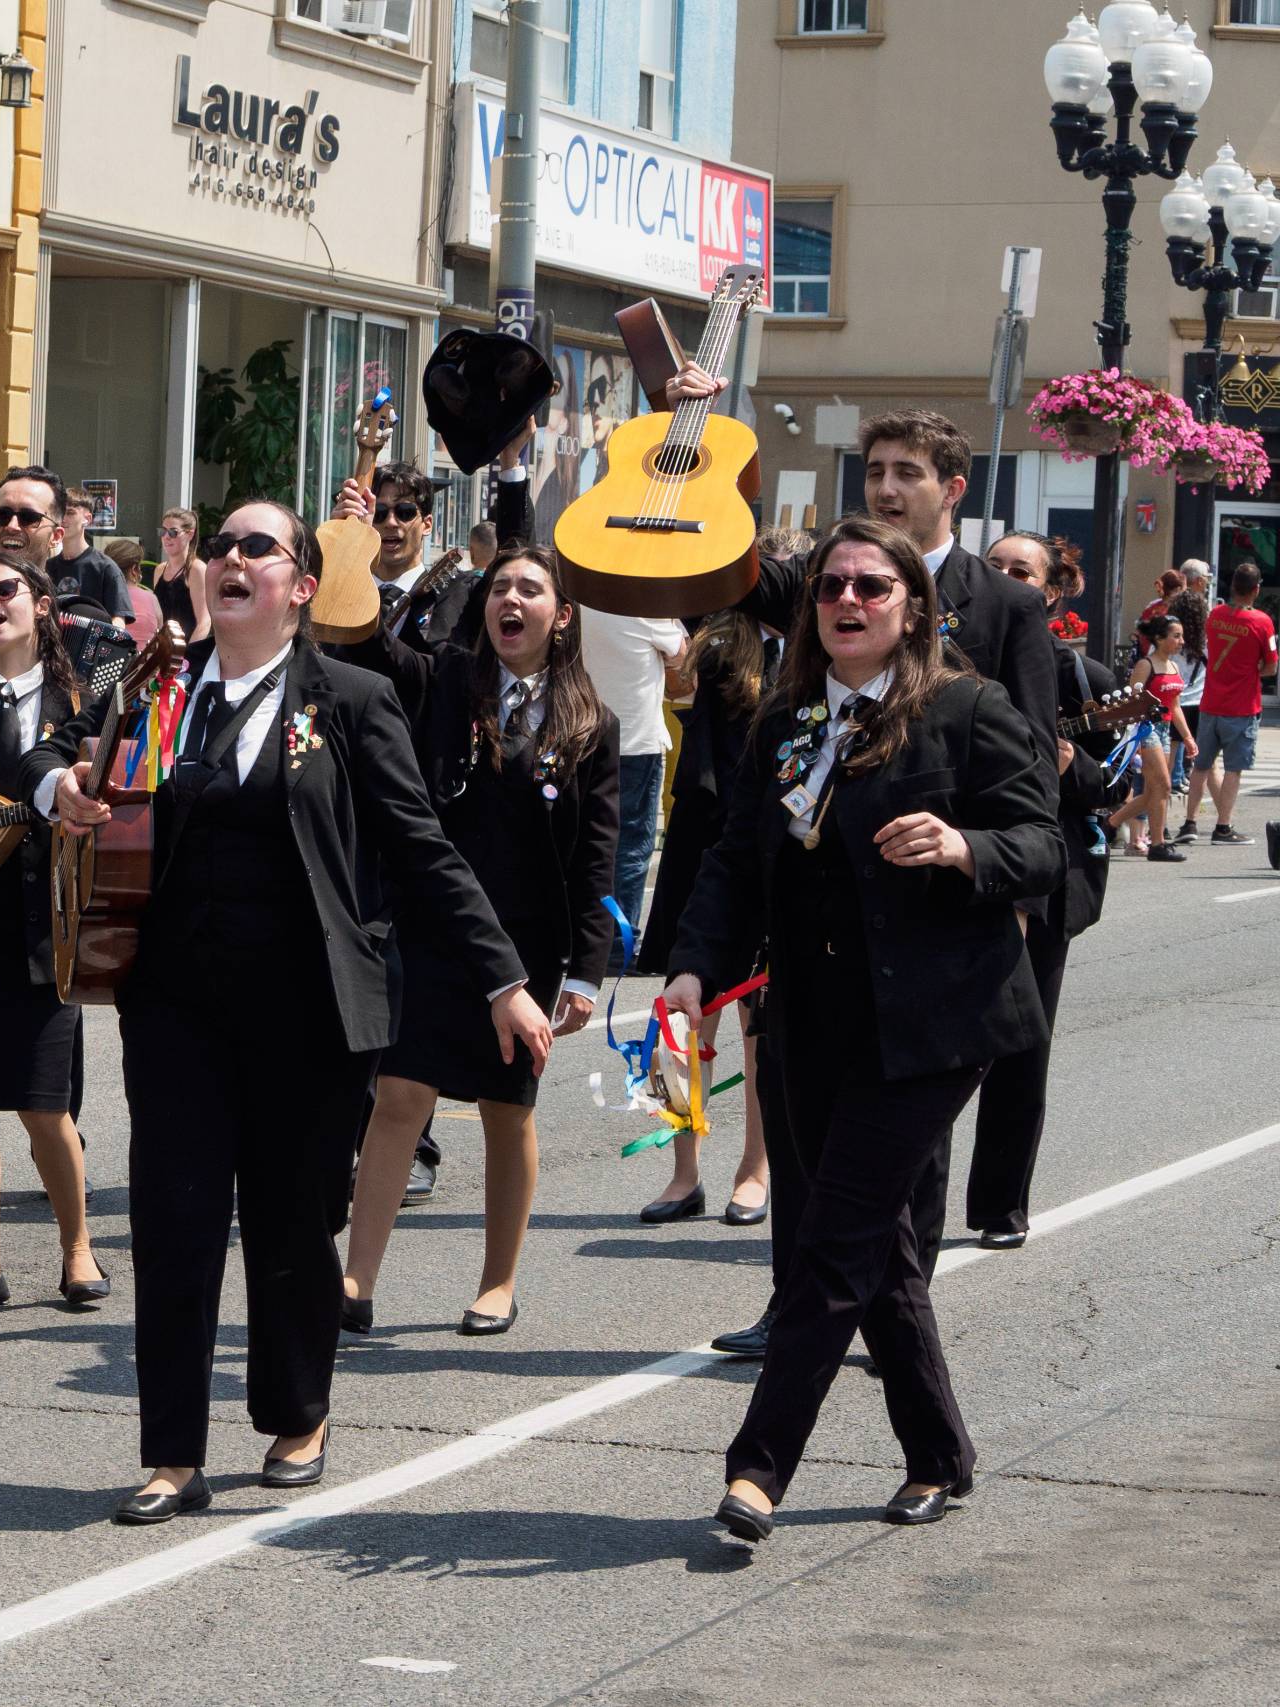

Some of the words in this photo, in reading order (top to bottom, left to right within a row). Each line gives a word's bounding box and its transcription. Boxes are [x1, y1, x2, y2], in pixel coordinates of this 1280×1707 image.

[174, 55, 340, 163] Laura's
[190, 135, 238, 169] hair
[244, 152, 317, 190] design
[564, 134, 696, 243] OPTICAL
[703, 174, 738, 253] KK
[1251, 383, 1263, 400] R
[1213, 633, 1238, 673] 7
